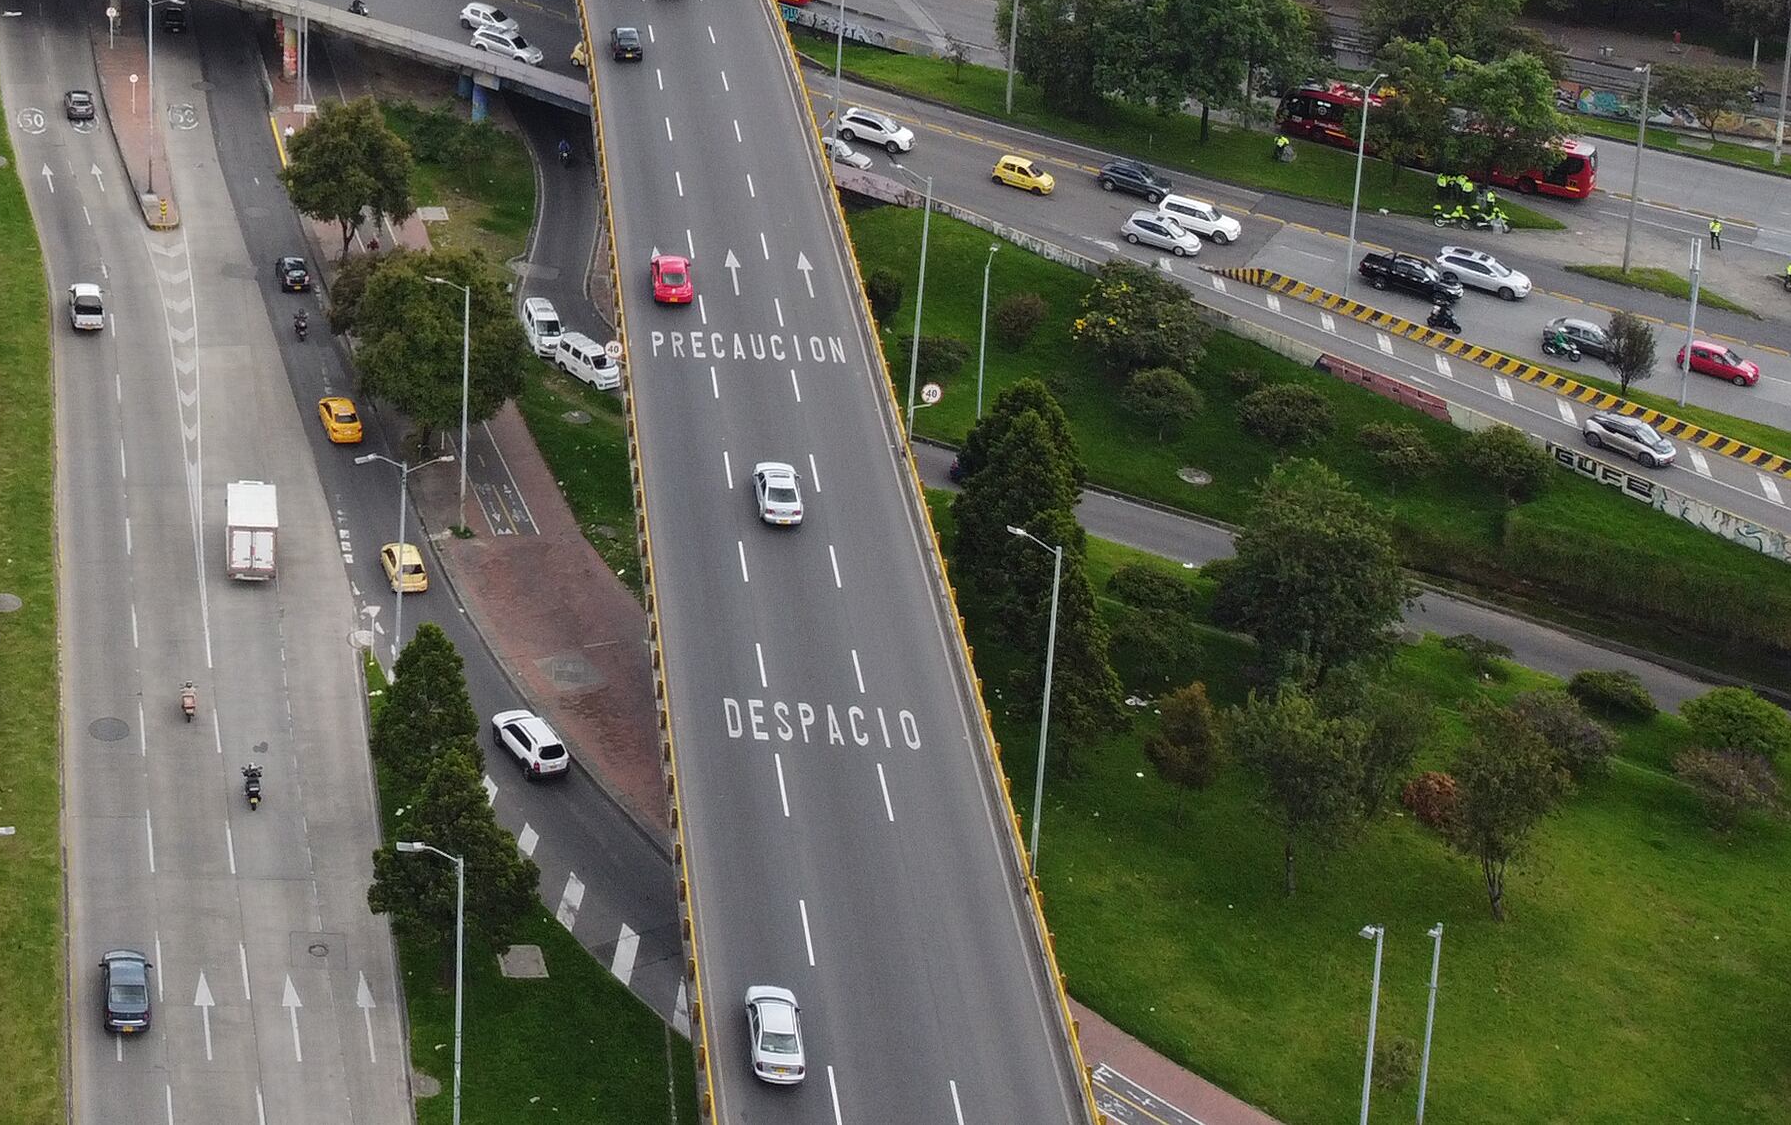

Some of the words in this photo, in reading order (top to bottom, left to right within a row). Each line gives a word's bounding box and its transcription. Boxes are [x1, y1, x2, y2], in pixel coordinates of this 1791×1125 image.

[608, 345, 619, 354] 40
[651, 331, 846, 364] PRECAUCION
[926, 389, 938, 398] 40
[723, 698, 922, 750] DESPACIO
